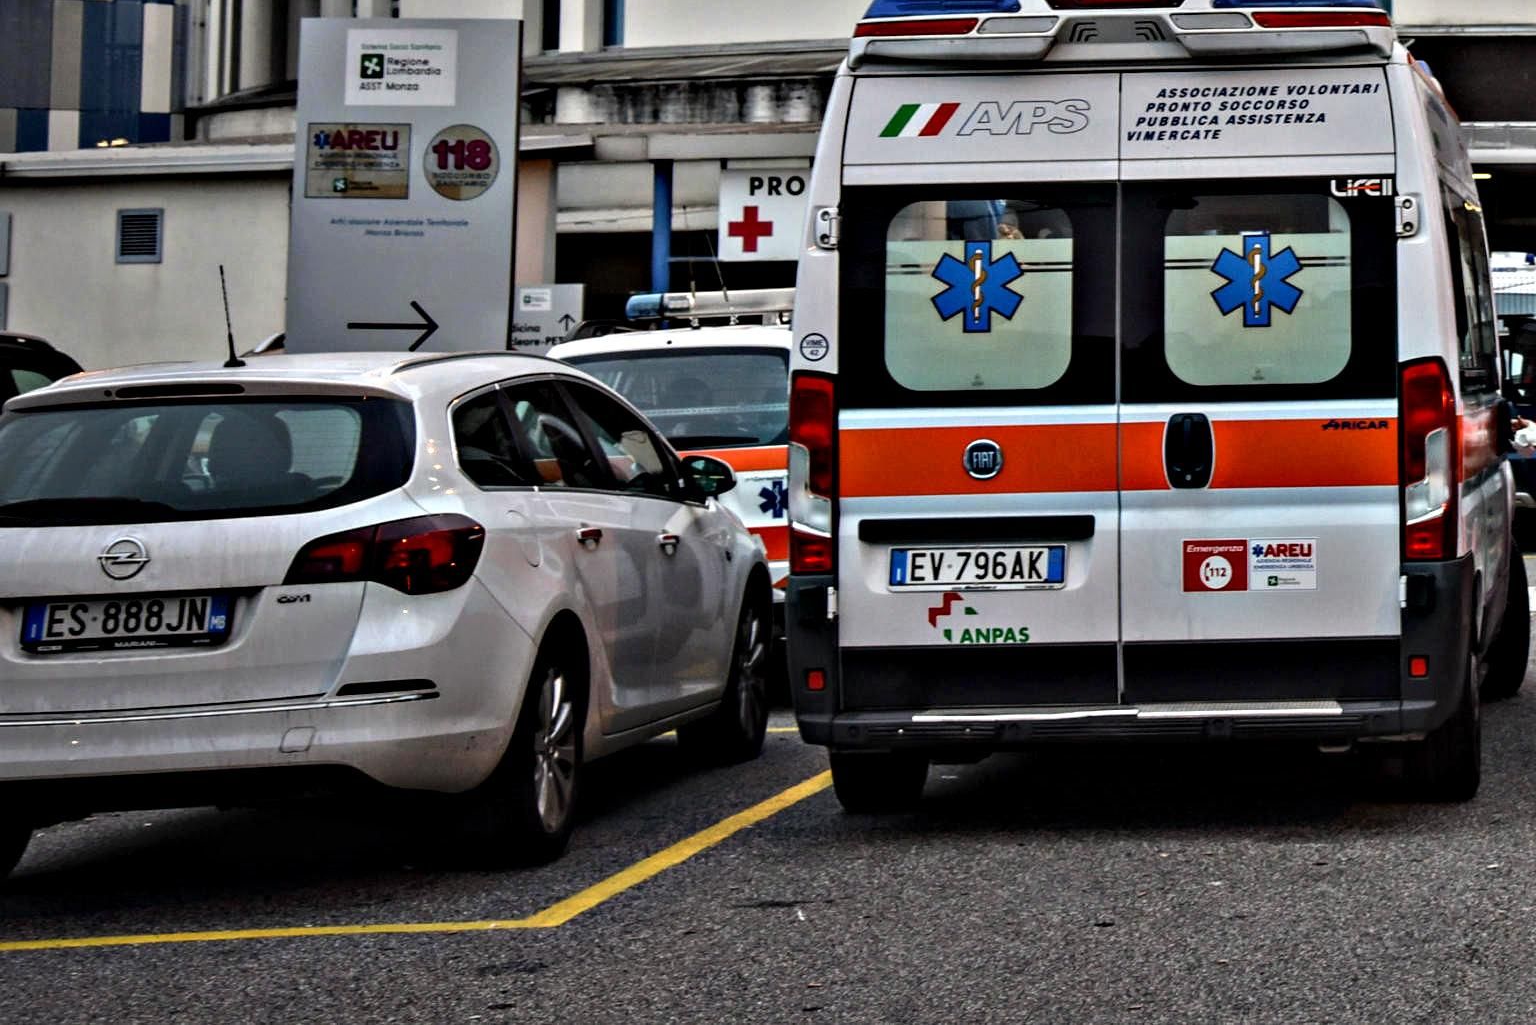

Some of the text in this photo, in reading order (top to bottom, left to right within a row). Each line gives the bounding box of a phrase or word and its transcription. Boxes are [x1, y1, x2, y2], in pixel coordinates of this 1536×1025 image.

[387, 57, 430, 67] Regione
[386, 67, 442, 76] Lombardia
[360, 82, 419, 91] ASST Monza
[1156, 83, 1380, 99] ASSOCIAZIONE VOLONTARI
[1146, 99, 1309, 113] PRONTO SOCCORSO
[1136, 112, 1326, 127] PUBBLICA ASSISTENZA
[330, 129, 399, 151] AREU
[1126, 129, 1222, 141] VIMERCATE
[432, 139, 492, 171] 118
[972, 451, 995, 469] FIAT
[1186, 544, 1244, 554] Emergenza
[1263, 543, 1313, 558] AREU
[1209, 567, 1227, 578] 112
[960, 626, 1030, 643] ANPAS
